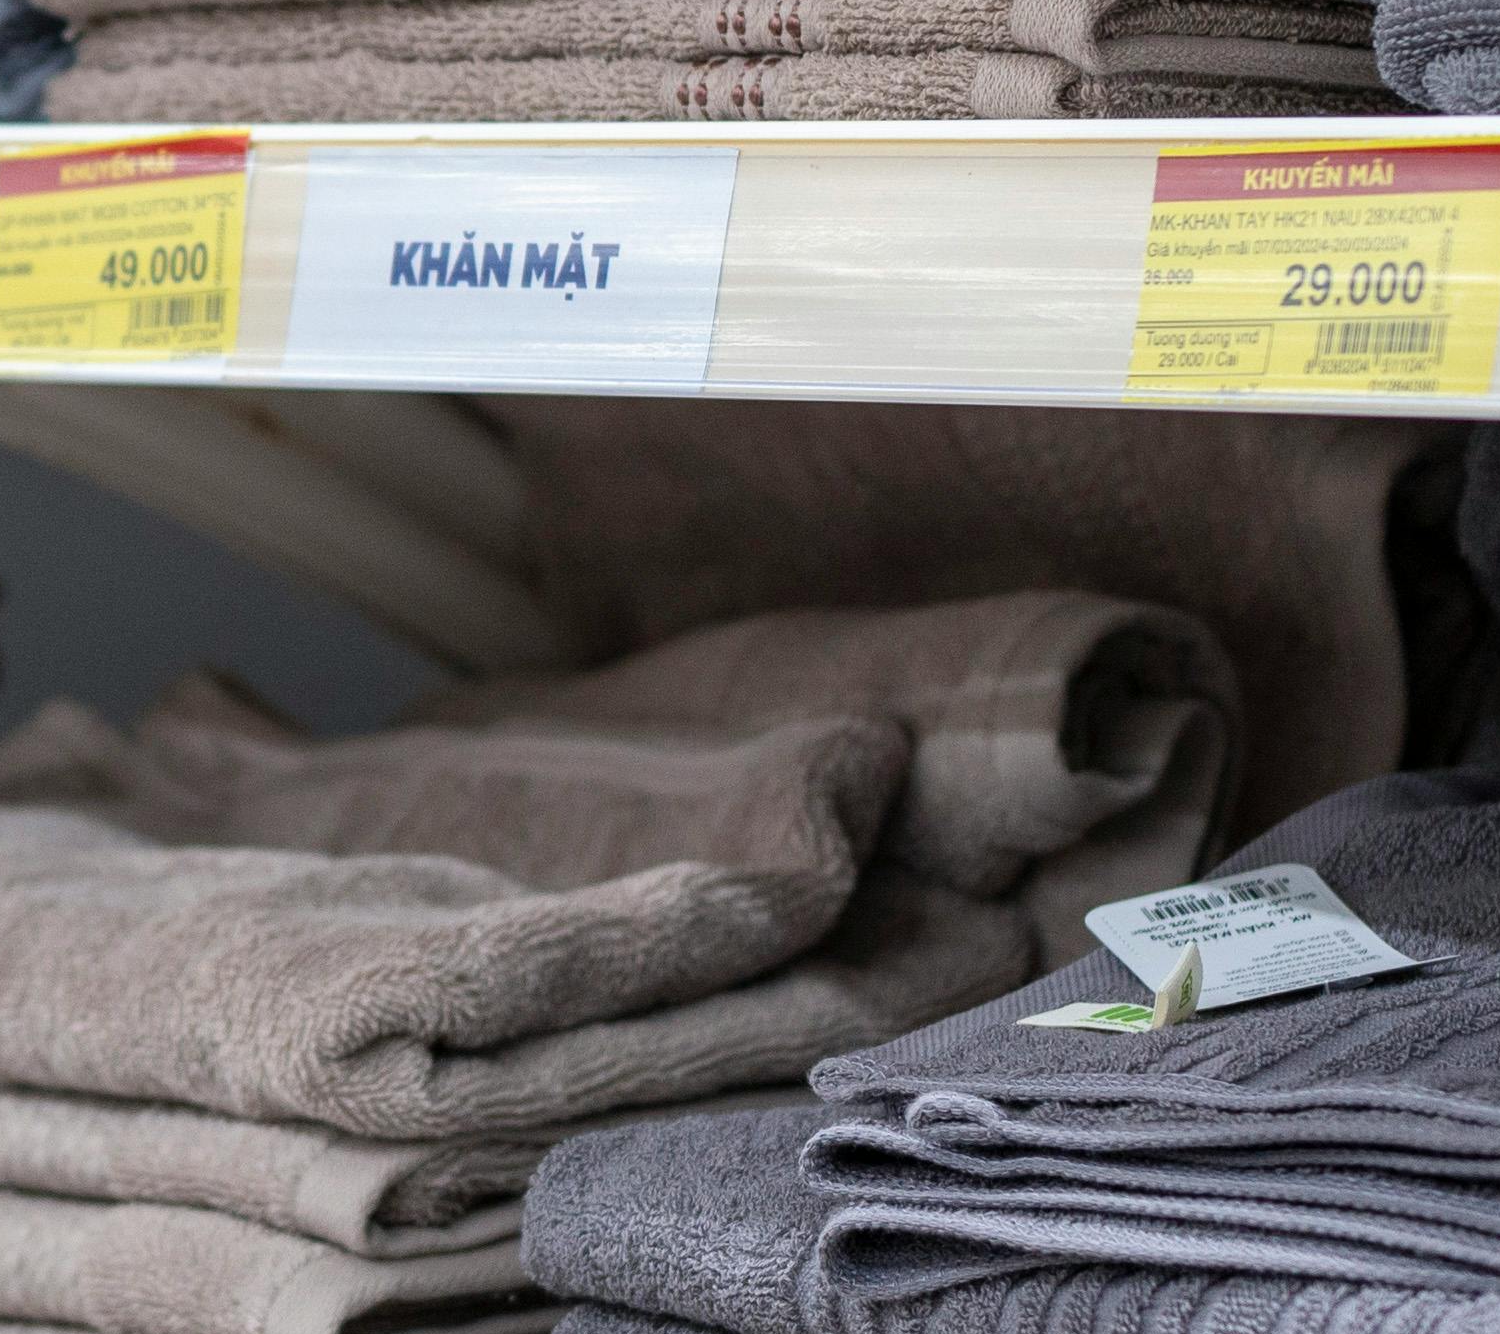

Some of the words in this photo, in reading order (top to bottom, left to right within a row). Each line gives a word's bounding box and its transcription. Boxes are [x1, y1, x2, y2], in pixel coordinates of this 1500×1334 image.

[1243, 156, 1342, 191] KHUYẾN
[1348, 158, 1395, 187] MÃI
[1150, 212, 1231, 232] MK-KHAN
[1237, 211, 1268, 230] TAY
[1273, 210, 1319, 229] HK21
[99, 242, 208, 289] 49.000
[390, 230, 514, 288] KHĂN
[521, 231, 621, 301] MẶT
[1280, 261, 1426, 308] 29.000
[1147, 331, 1186, 350] Tuong
[1158, 353, 1206, 368] 29.000
